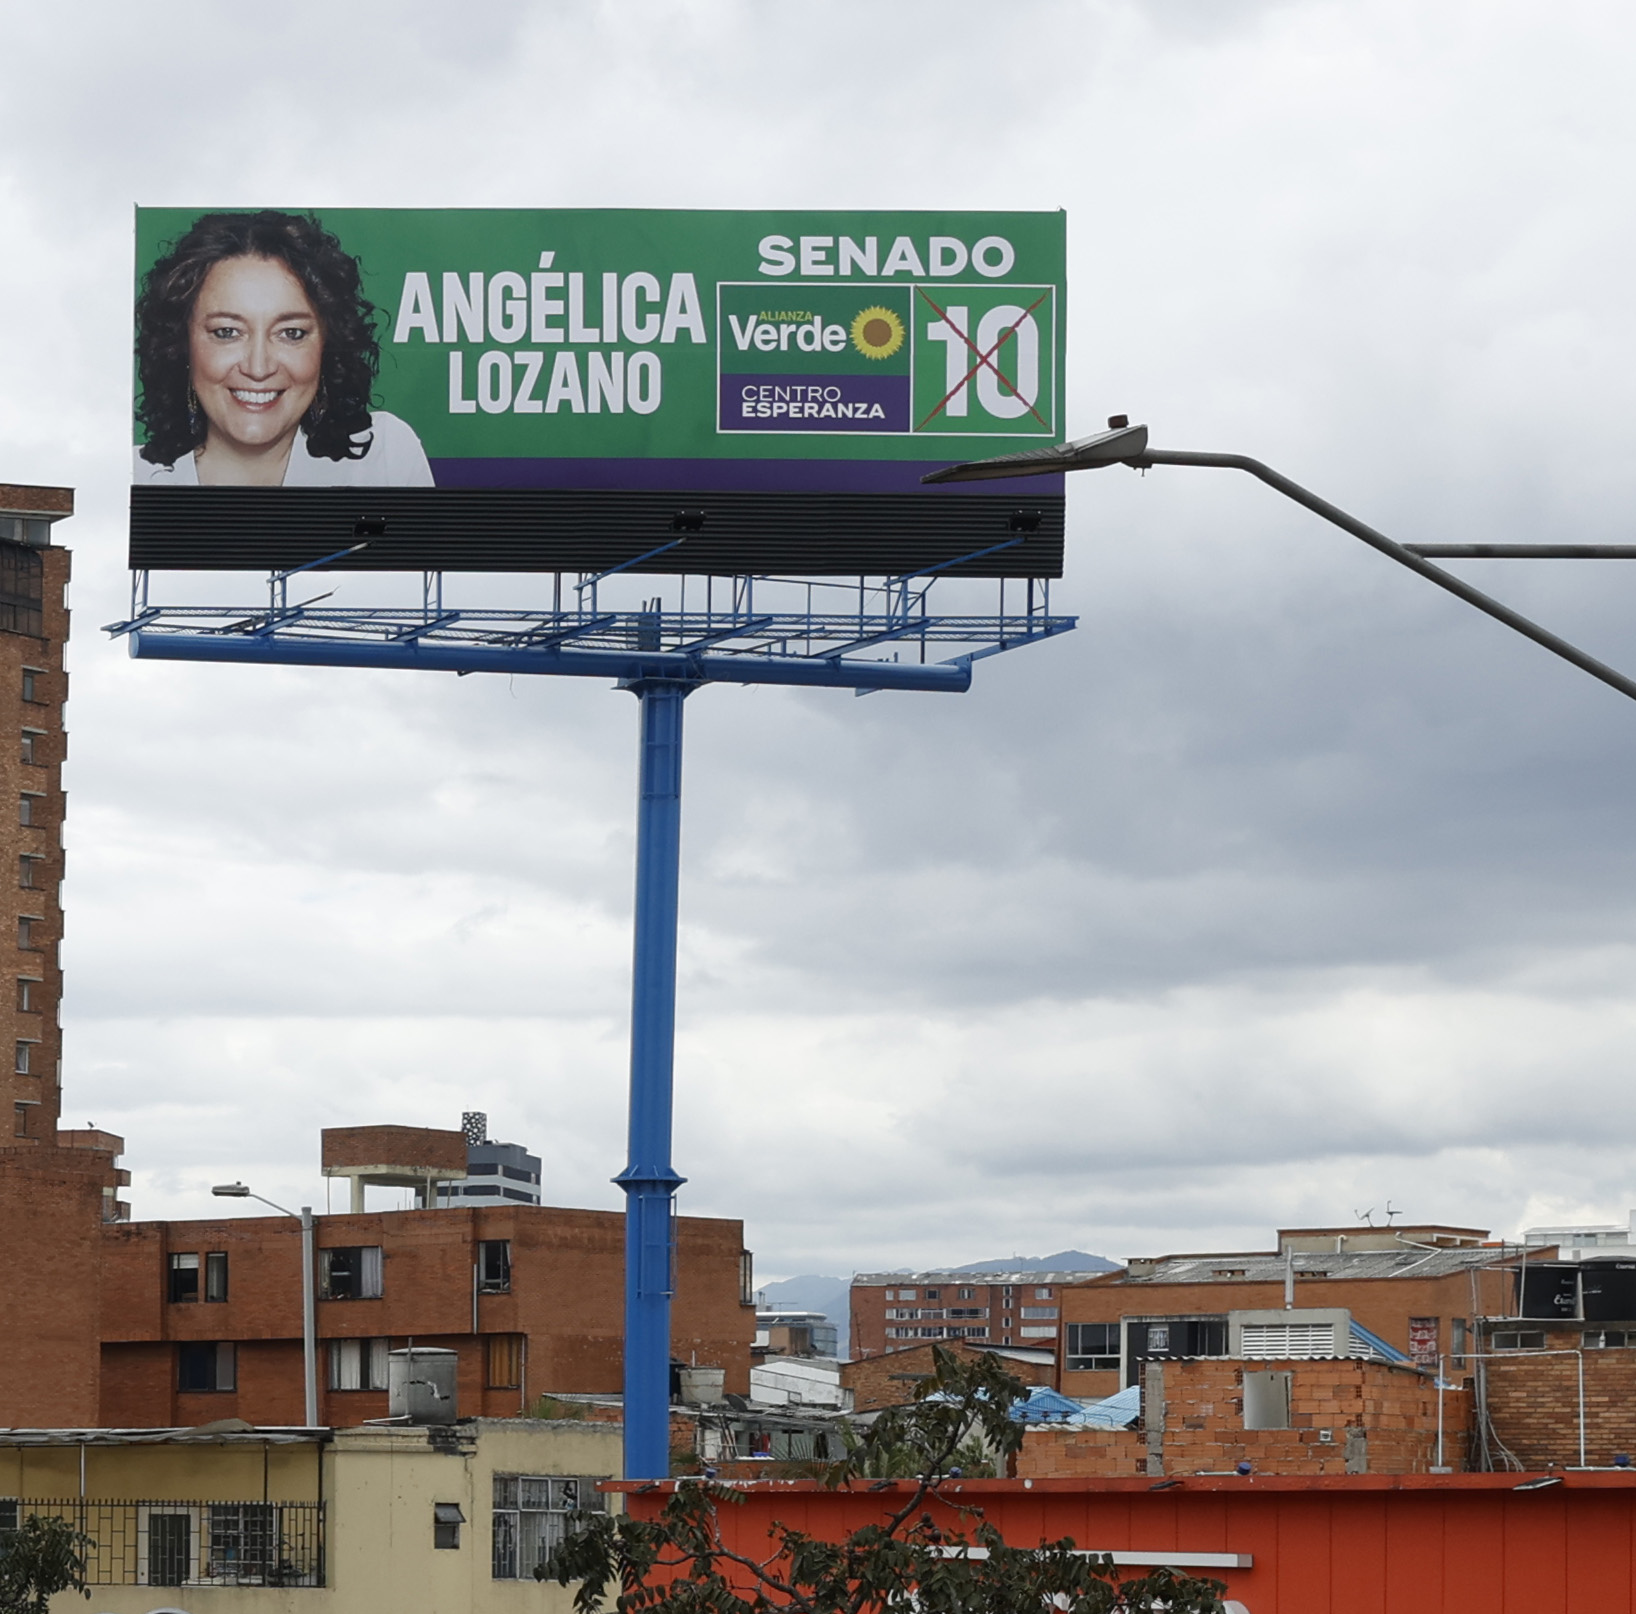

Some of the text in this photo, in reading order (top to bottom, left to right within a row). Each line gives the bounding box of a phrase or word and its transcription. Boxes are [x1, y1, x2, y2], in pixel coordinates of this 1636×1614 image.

[758, 235, 1015, 278] SENADO
[393, 251, 707, 344] ANGÉLICA
[759, 311, 813, 322] ALIANZA
[728, 315, 847, 352] Verde
[927, 305, 1039, 419] 10
[449, 350, 661, 415] LOZANO
[741, 385, 841, 401] CENTRO
[741, 402, 885, 419] ESPERANZA
